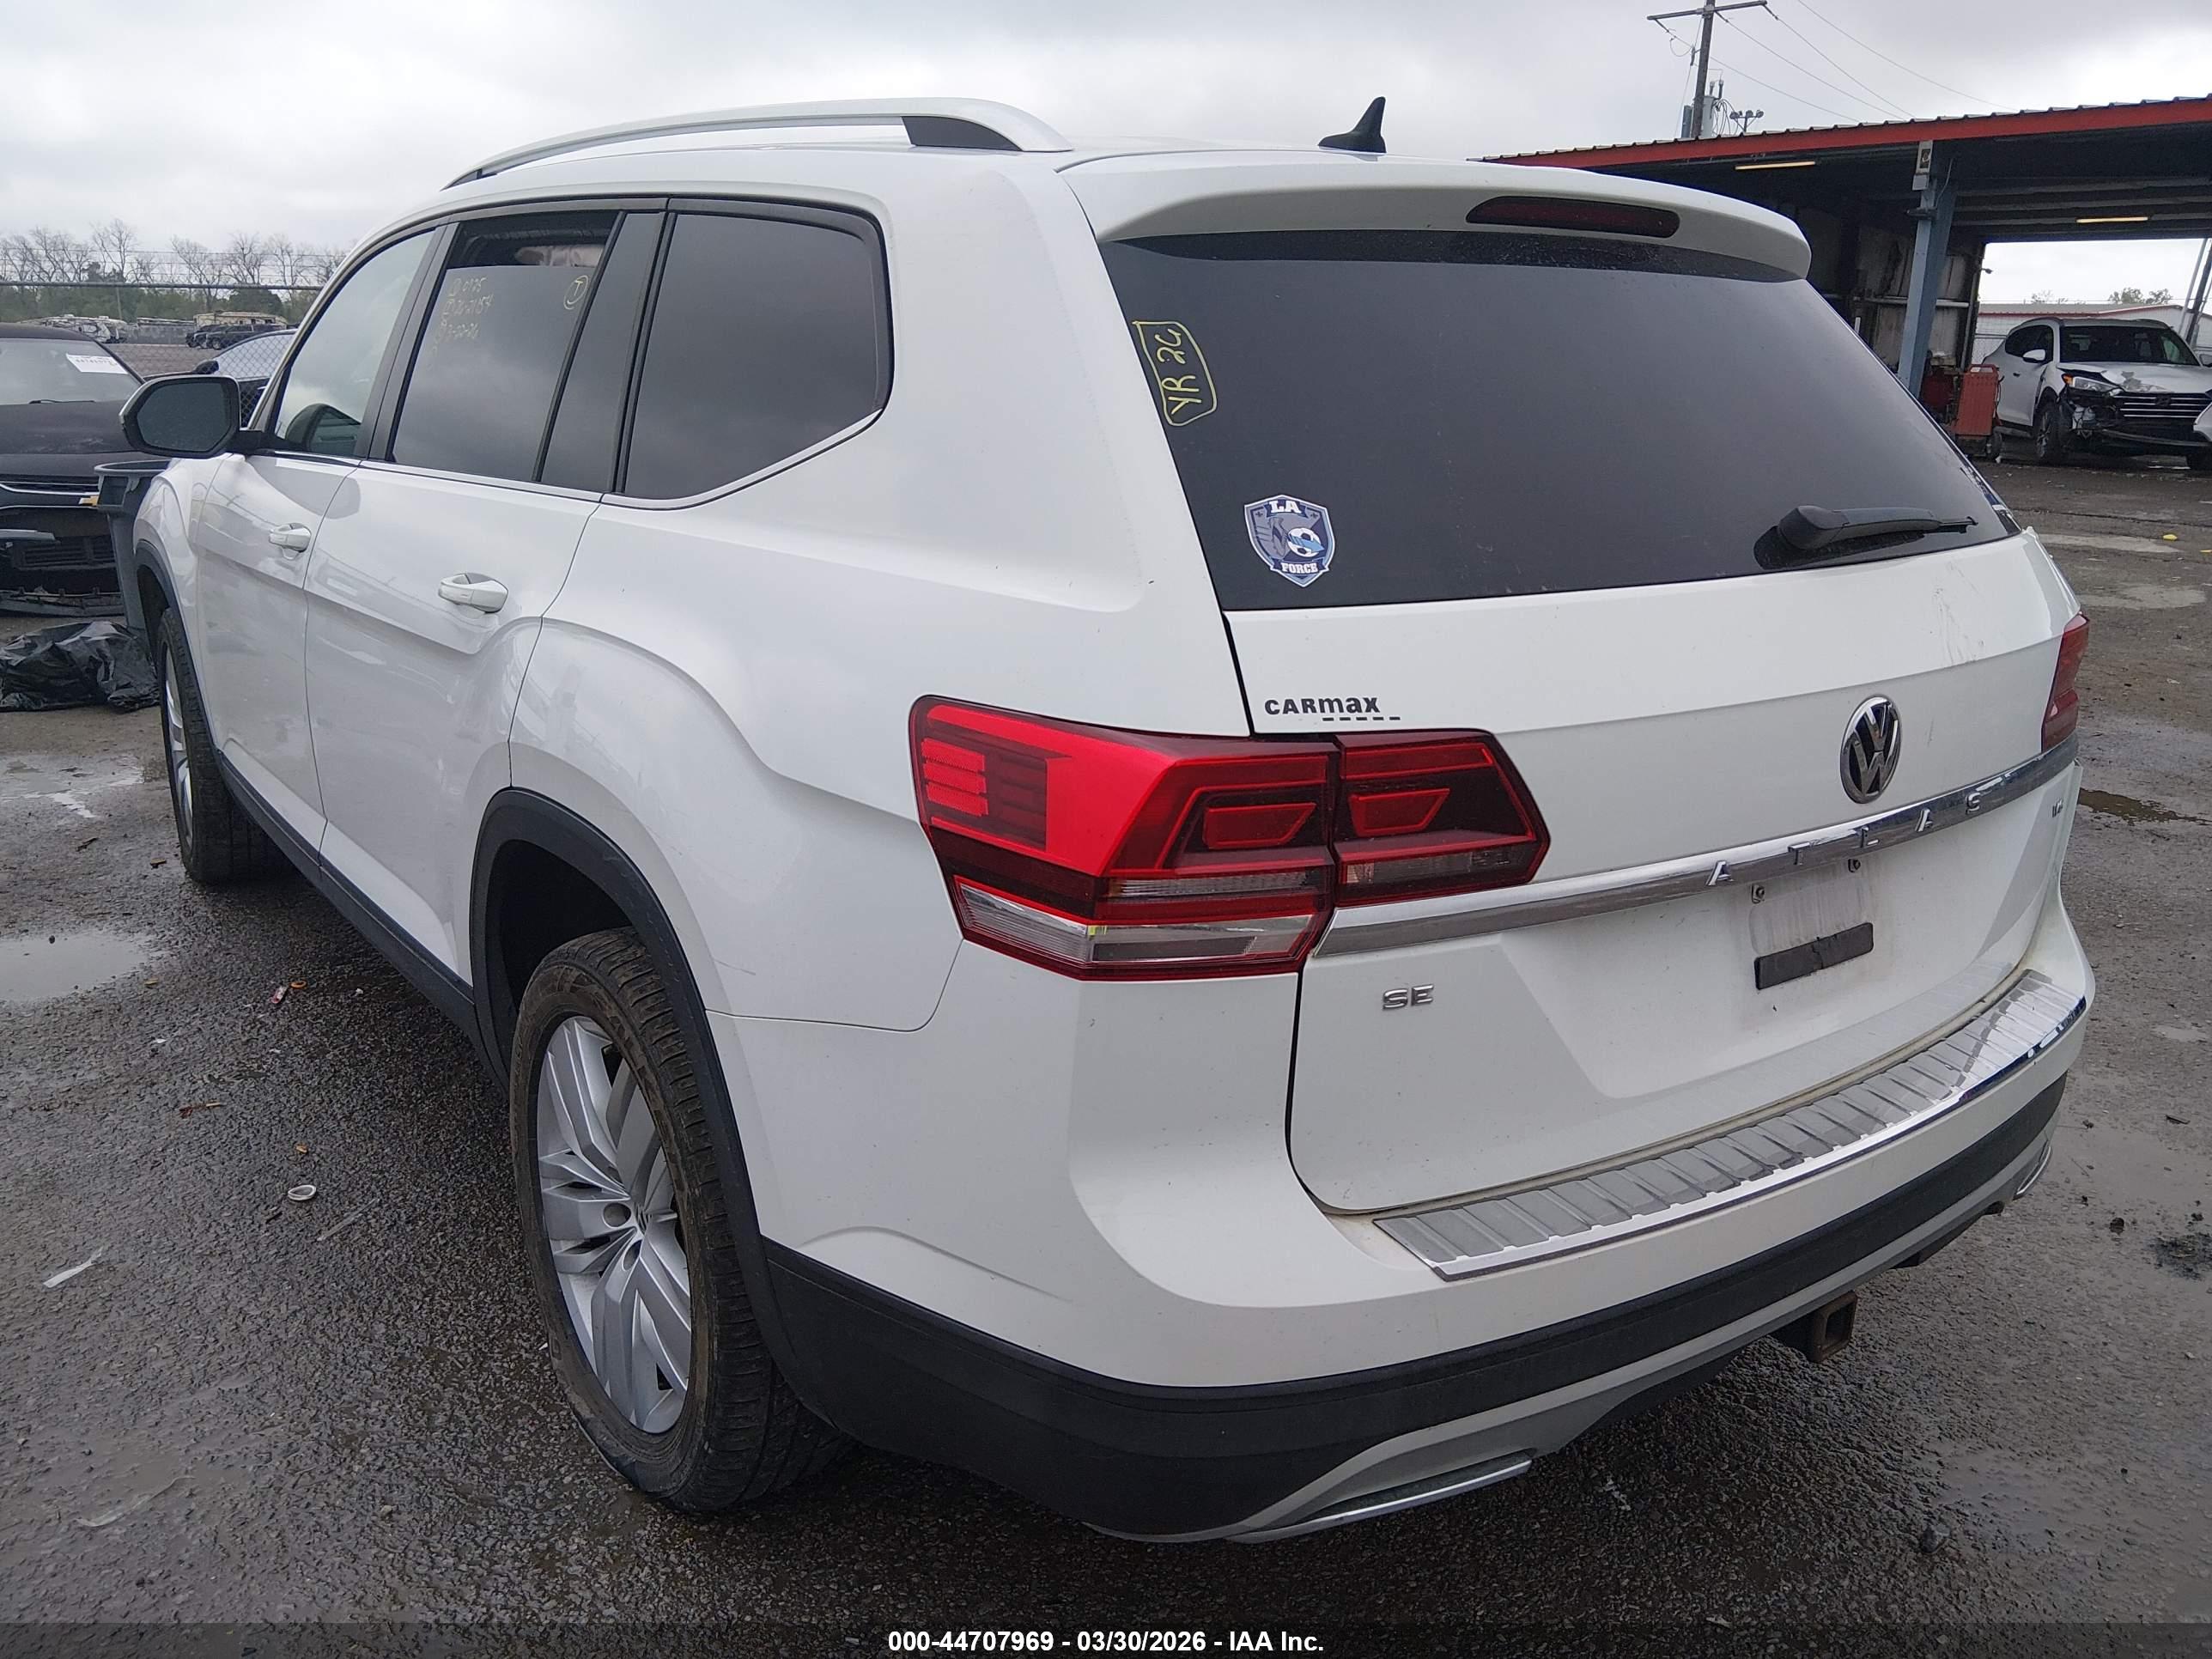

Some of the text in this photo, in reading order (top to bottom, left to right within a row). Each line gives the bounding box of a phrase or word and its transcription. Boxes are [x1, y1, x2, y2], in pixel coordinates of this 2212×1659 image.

[1161, 374, 1202, 415] YR
[1269, 500, 1302, 514] LA
[1280, 562, 1319, 574] FORCE
[1705, 792, 1982, 886] ATLAS
[1382, 984, 1434, 1010] SE
